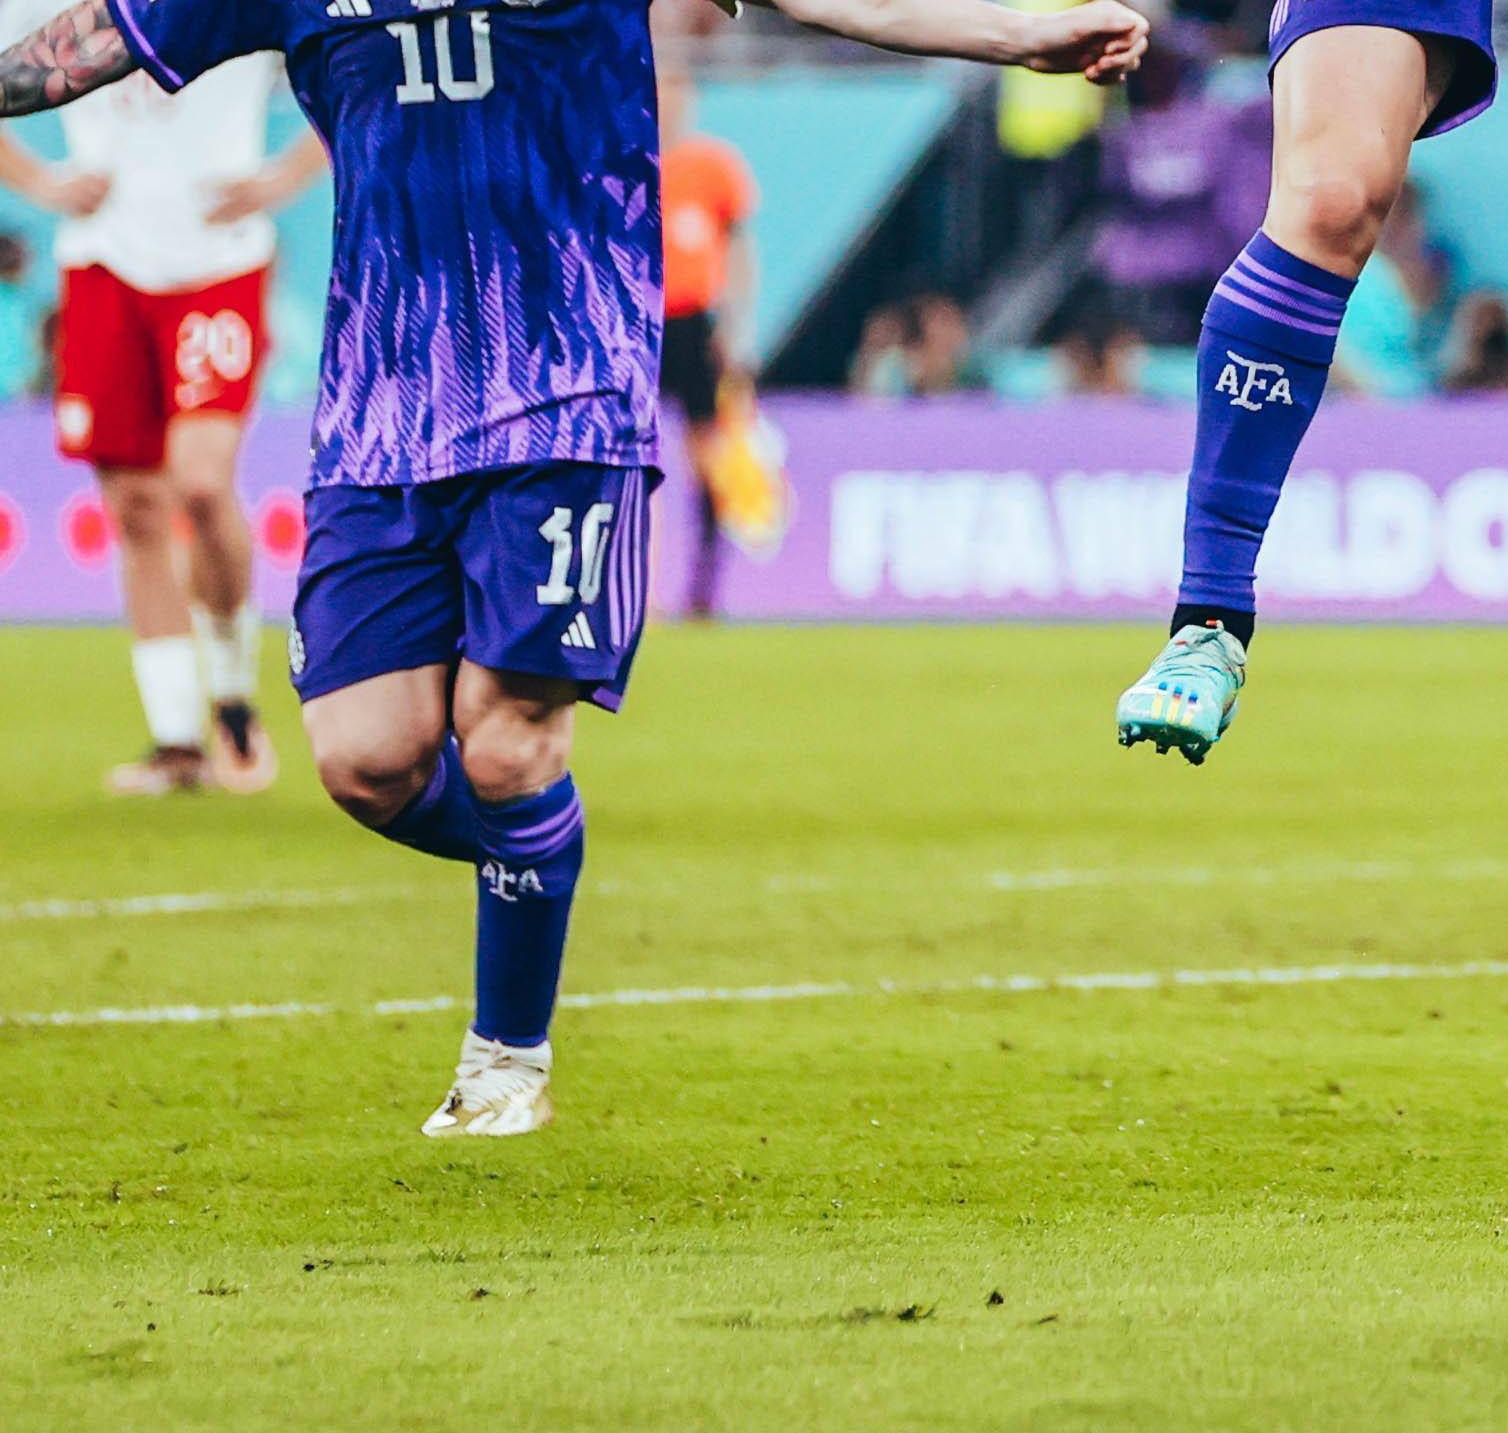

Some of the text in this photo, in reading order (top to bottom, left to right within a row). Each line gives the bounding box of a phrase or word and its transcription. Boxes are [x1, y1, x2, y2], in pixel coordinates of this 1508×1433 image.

[385, 9, 494, 105] 10
[1214, 349, 1294, 412] AFA
[536, 501, 615, 606] 10
